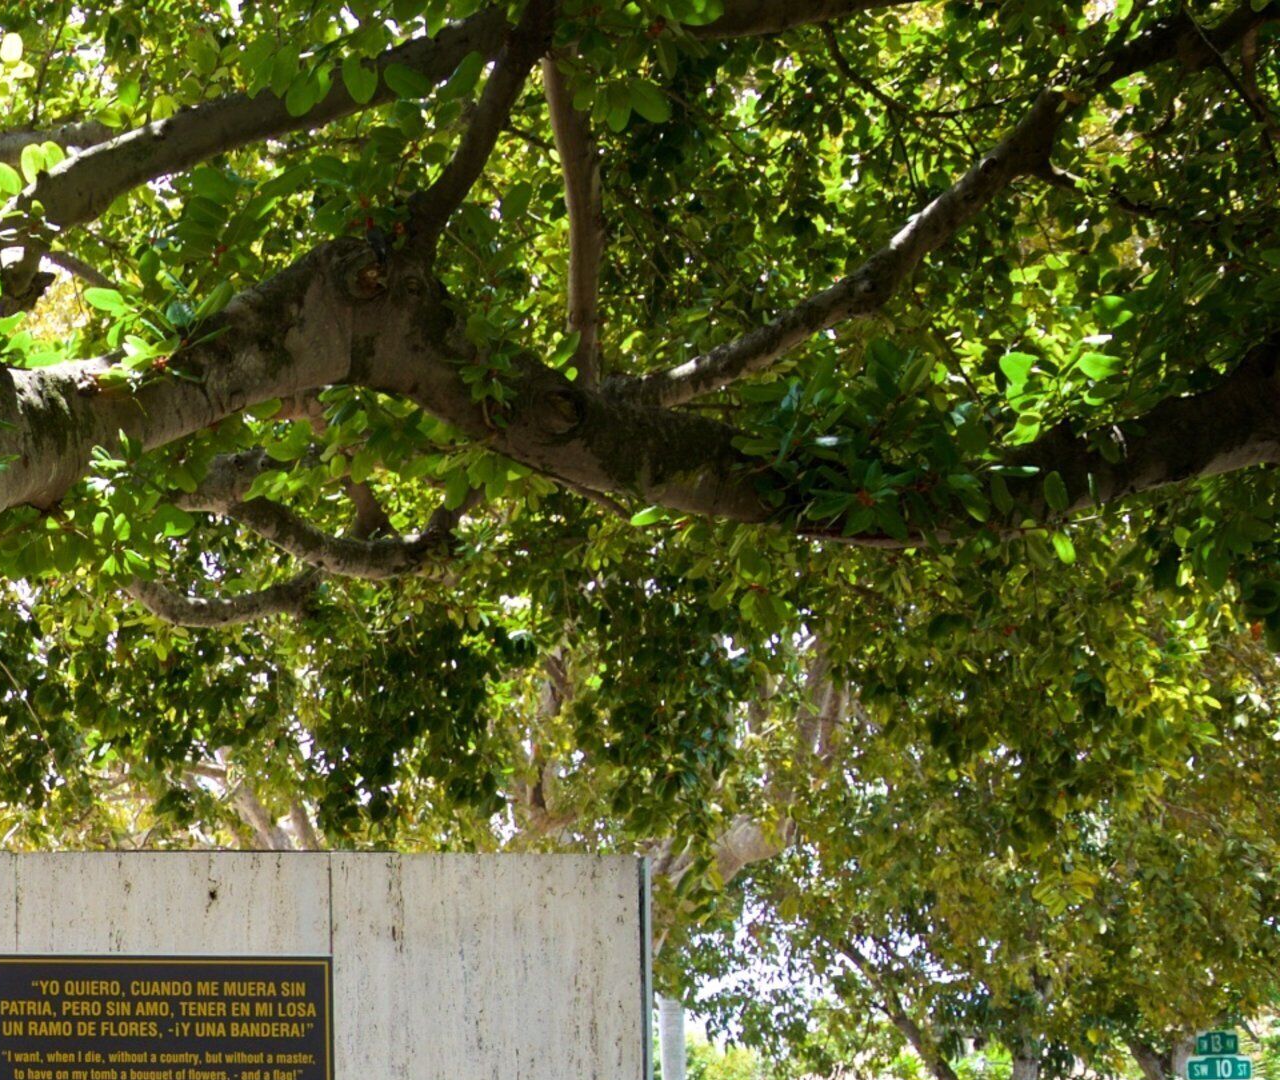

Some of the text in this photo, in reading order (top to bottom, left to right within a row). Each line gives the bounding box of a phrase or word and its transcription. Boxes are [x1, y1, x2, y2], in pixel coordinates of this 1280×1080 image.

[63, 980, 126, 998] QUIERO,
[130, 981, 193, 997] CUANDO
[196, 981, 220, 997] ME
[222, 982, 278, 998] MUERA
[280, 981, 307, 998] SIN
[0, 1000, 317, 1019] PATRIA, PERO SIN AMO, TENER EN MI LOSA
[1, 1021, 24, 1037] UN
[27, 1021, 73, 1037] RAMO
[76, 1021, 97, 1037] DE
[100, 1021, 164, 1039] FLORES,
[194, 1022, 227, 1038] UNA
[1211, 1034, 1222, 1053] 13
[45, 1051, 76, 1064] when
[77, 1051, 83, 1063] I
[107, 1051, 148, 1064] without
[149, 1053, 158, 1064] a
[159, 1052, 202, 1066] country,
[204, 1051, 223, 1064] but
[224, 1051, 265, 1065] without
[266, 1054, 274, 1065] a
[13, 1068, 25, 1080] to
[27, 1068, 54, 1080] have
[55, 1070, 70, 1080] on
[89, 1068, 119, 1080] tomb
[120, 1071, 128, 1080] a
[1193, 1059, 1248, 1078] SW 10 ST
